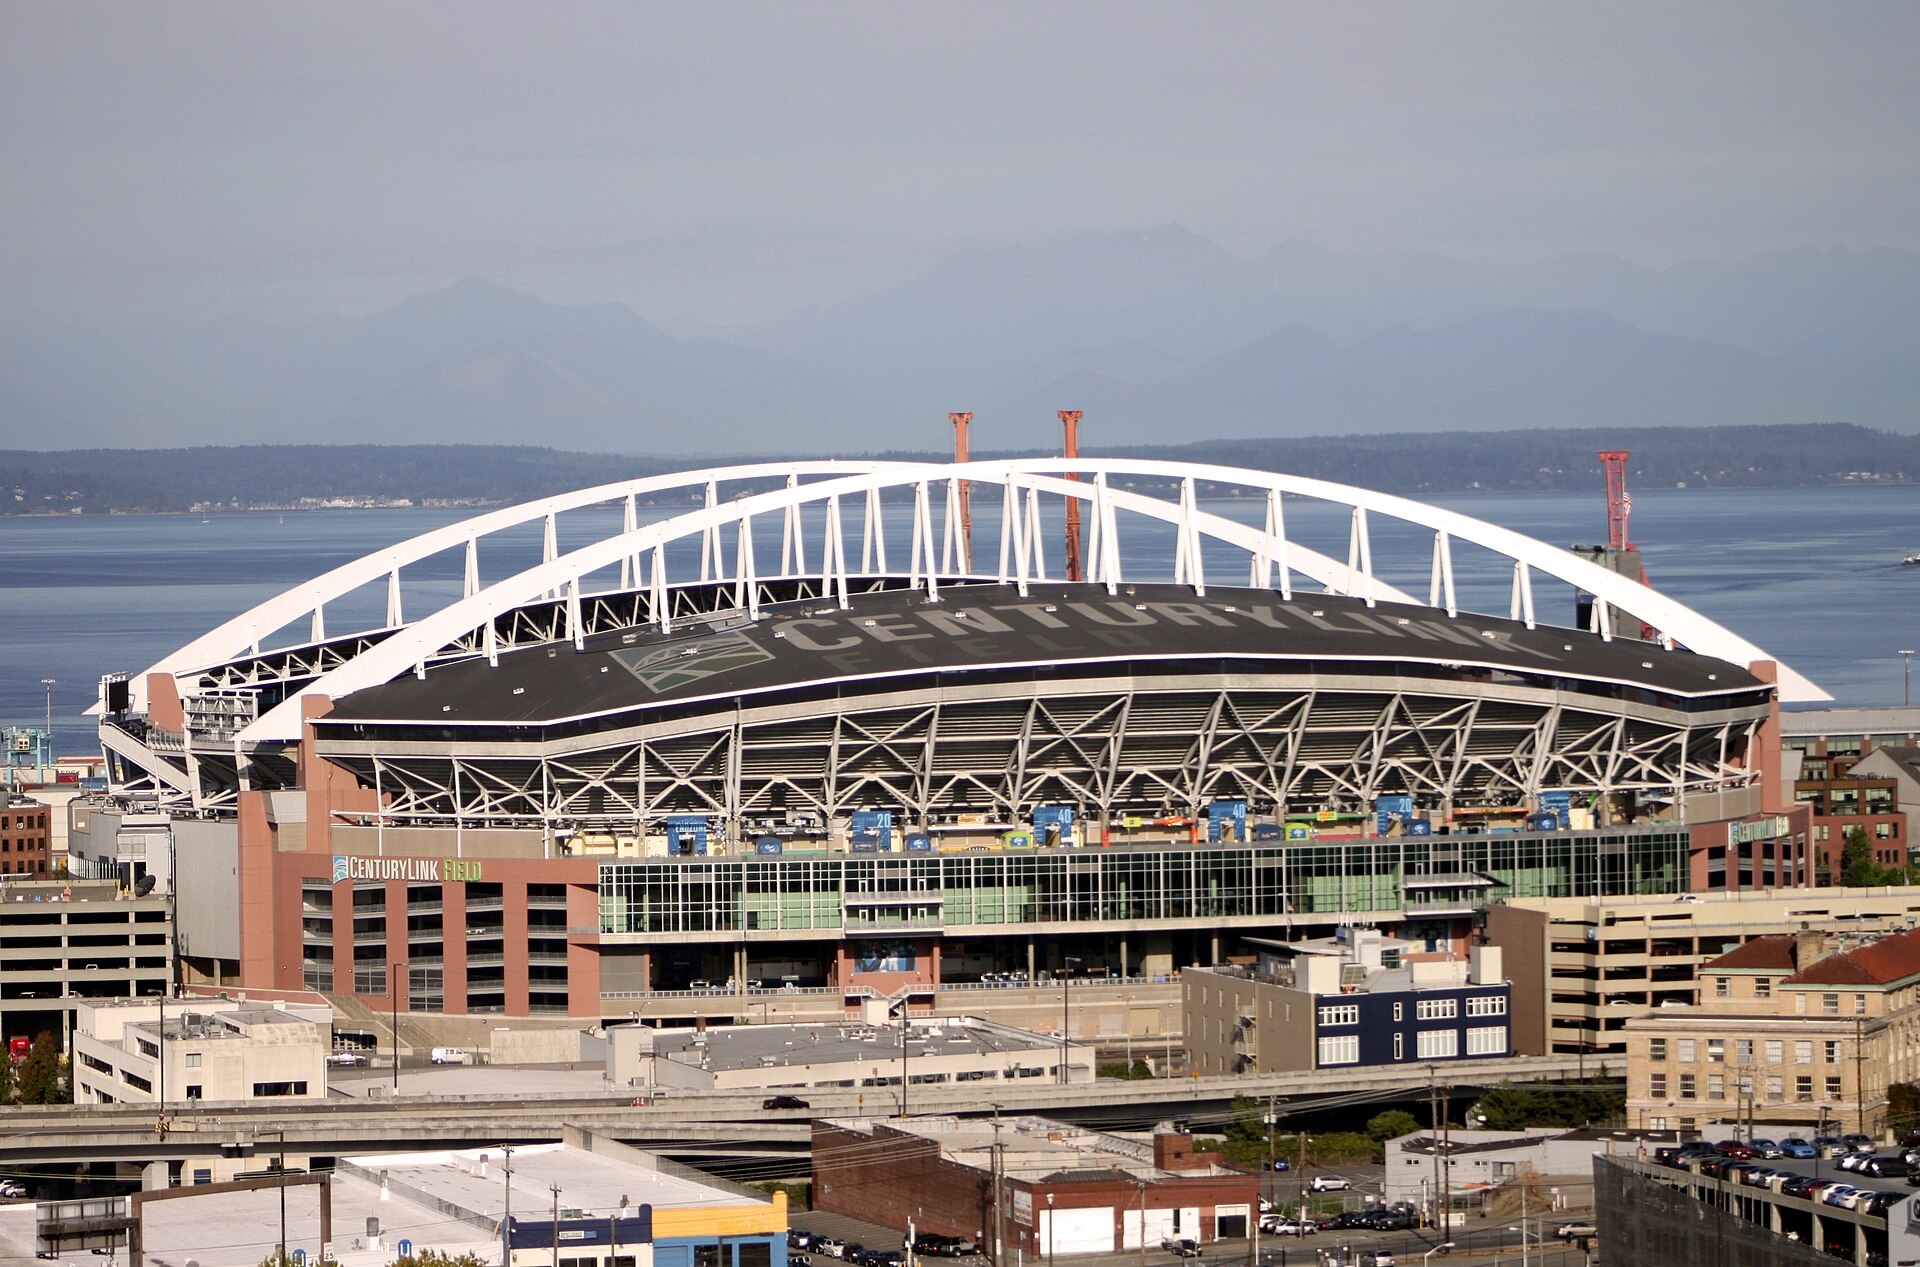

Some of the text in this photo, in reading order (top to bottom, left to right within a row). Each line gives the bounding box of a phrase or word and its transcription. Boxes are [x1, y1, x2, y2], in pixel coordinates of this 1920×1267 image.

[771, 601, 1563, 661] CENTURYLINK
[822, 630, 1152, 674] FIELD
[1232, 803, 1245, 818] 40
[1399, 798, 1412, 812] 20
[877, 813, 891, 828] 20
[1058, 808, 1071, 824] 40
[325, 1252, 334, 1260] 25
